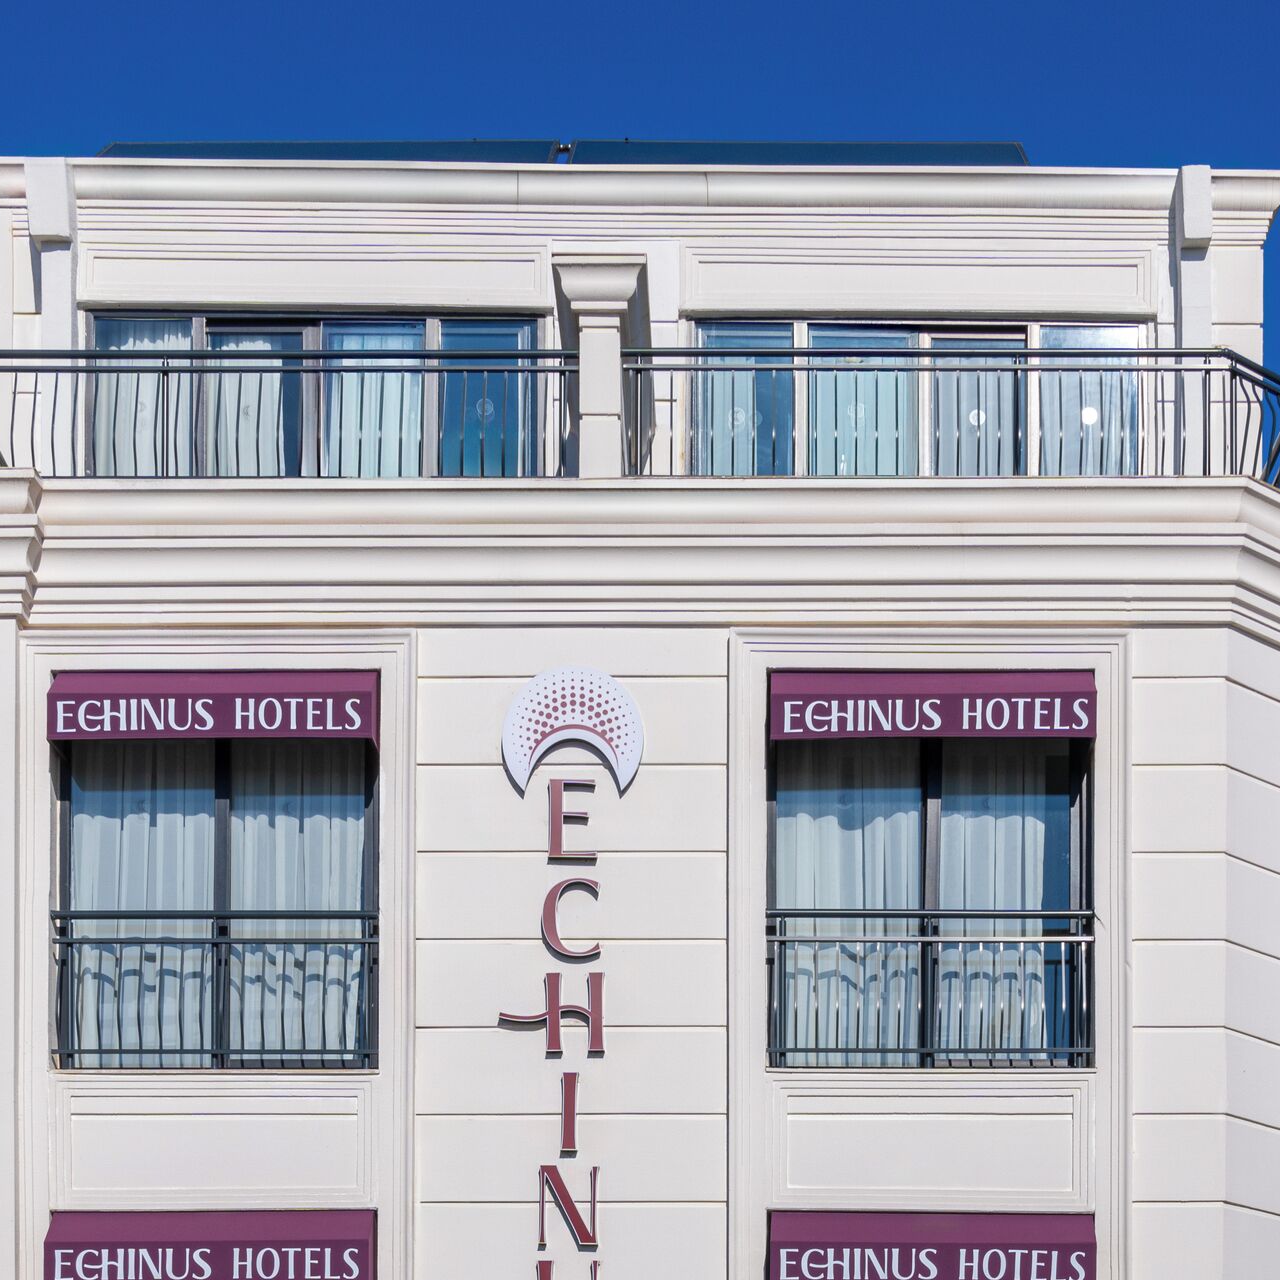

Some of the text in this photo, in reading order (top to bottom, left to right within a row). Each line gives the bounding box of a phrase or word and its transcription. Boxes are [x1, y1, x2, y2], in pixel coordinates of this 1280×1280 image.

[56, 697, 362, 732] ECHINUS HOTELS
[783, 697, 1089, 733] ECHINUS HOTELS
[54, 1247, 360, 1280] ECHINUS HOTELS
[779, 1248, 938, 1280] ECHINUS
